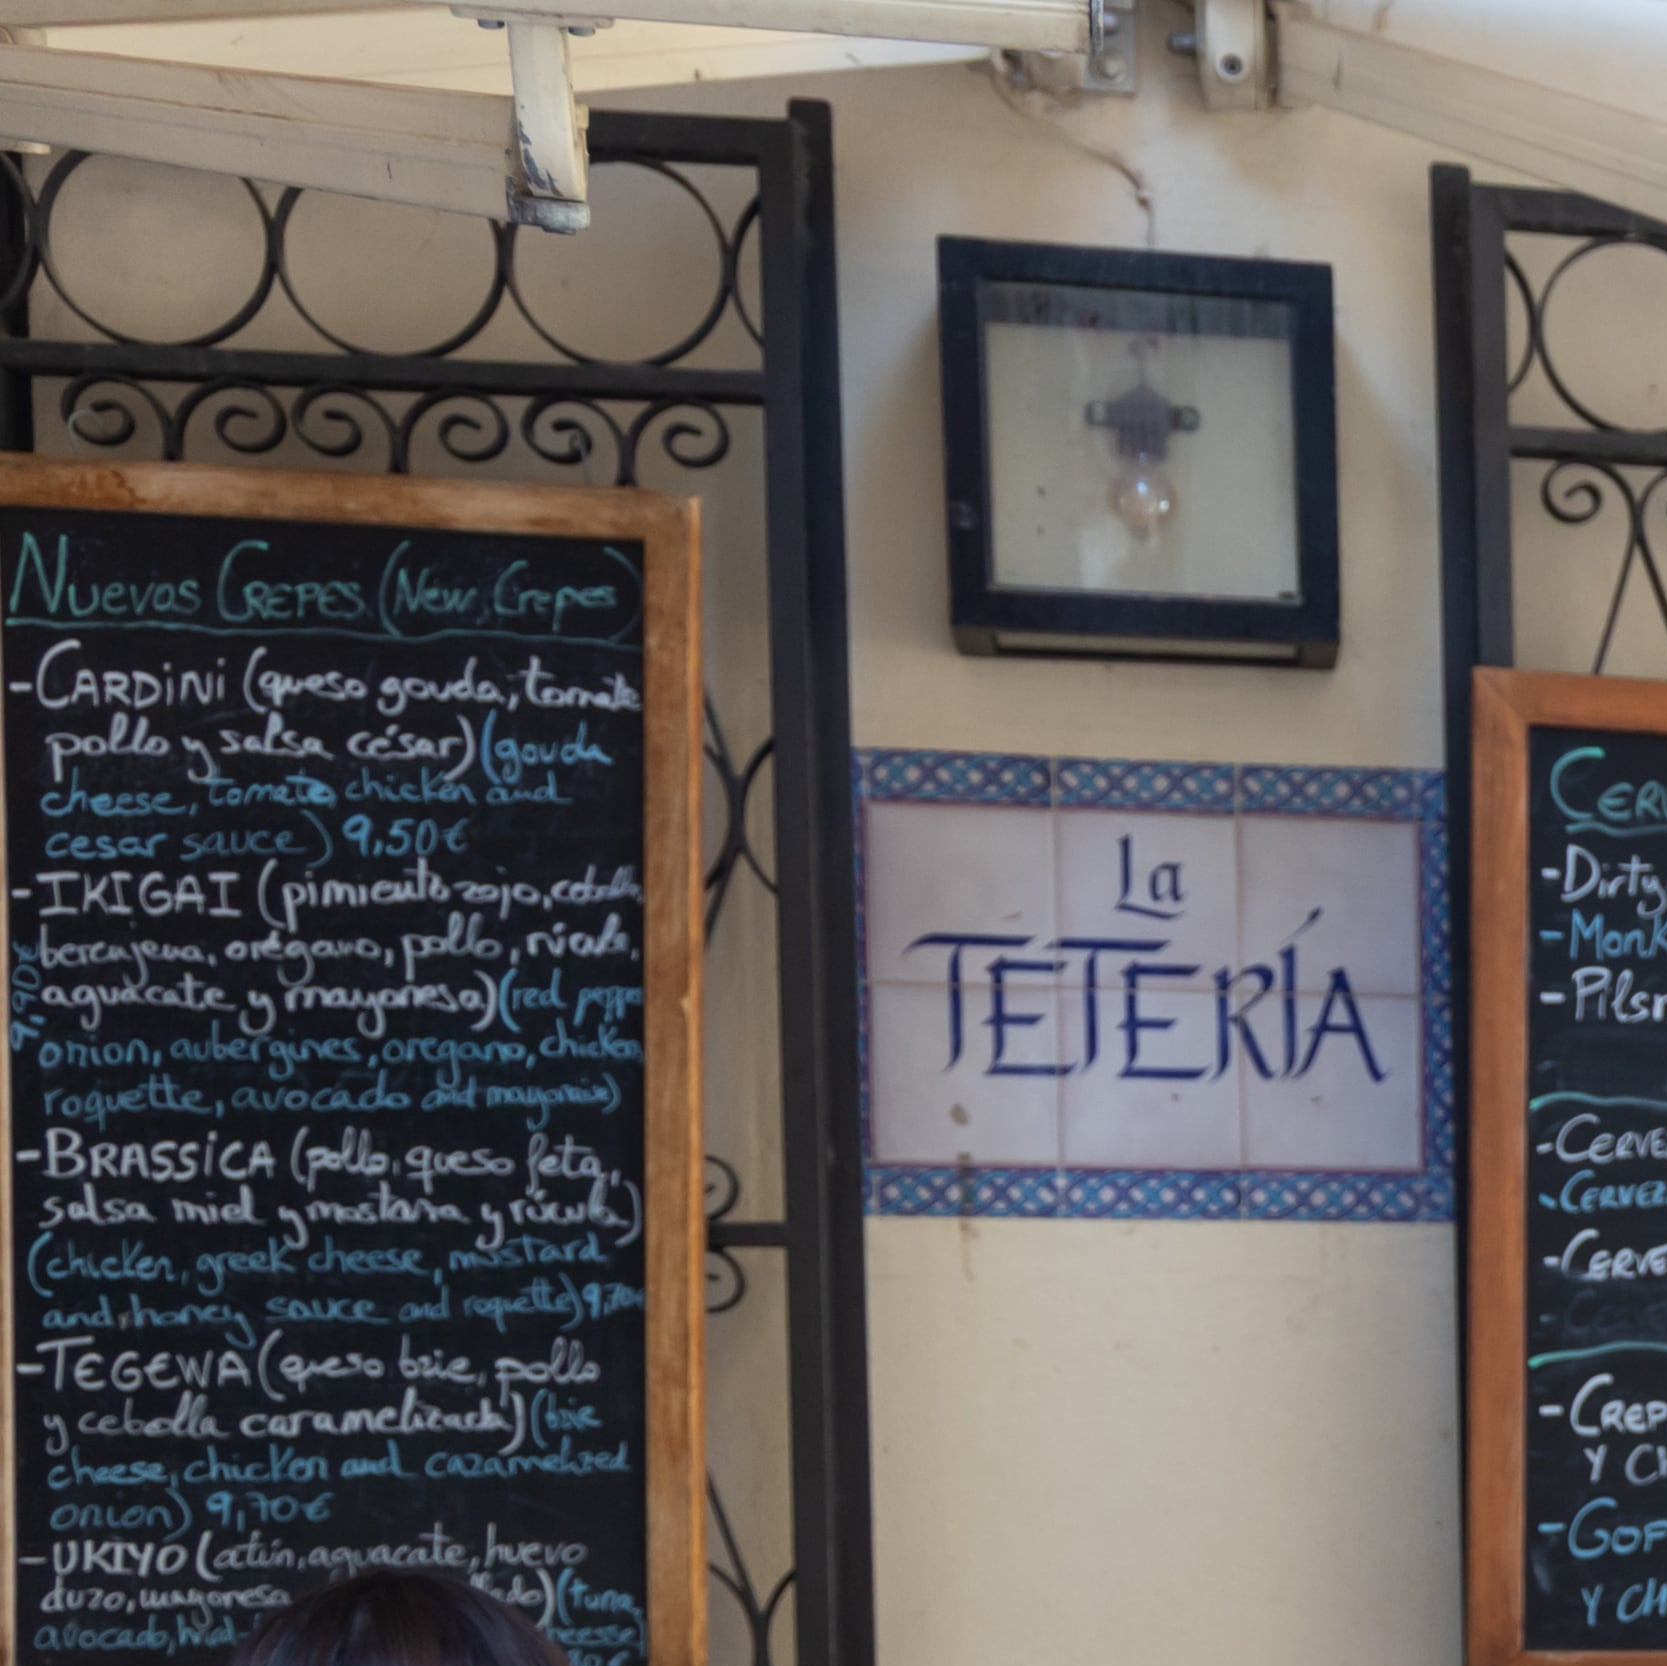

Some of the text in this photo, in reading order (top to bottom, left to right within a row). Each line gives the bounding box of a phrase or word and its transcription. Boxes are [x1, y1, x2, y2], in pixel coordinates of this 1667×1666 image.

[243, 646, 367, 713] (queso
[44, 712, 171, 783] pollo
[181, 735, 219, 783] y
[218, 711, 335, 760] salsa
[480, 708, 615, 785] (gouda
[344, 765, 478, 806] chicken
[485, 770, 573, 805] and
[45, 832, 168, 860] cesar
[1115, 833, 1186, 919] La
[401, 911, 520, 982] pollo,
[238, 990, 277, 1036] y
[901, 906, 1390, 1084] TETERÍA
[231, 1068, 411, 1112] avocado
[405, 1145, 516, 1195] queso
[38, 1182, 505, 1251] salsa miel y y
[196, 1236, 297, 1298] greek
[42, 1294, 114, 1329] and
[266, 1296, 392, 1326] sauce
[398, 1285, 450, 1322] and
[494, 1336, 601, 1408] pollo
[42, 1414, 70, 1456] y
[77, 1390, 231, 1439] cebolla
[340, 1438, 420, 1480] and
[1583, 1444, 1608, 1484] Y
[485, 1522, 589, 1570] huevo
[1581, 1583, 1604, 1627] Y
